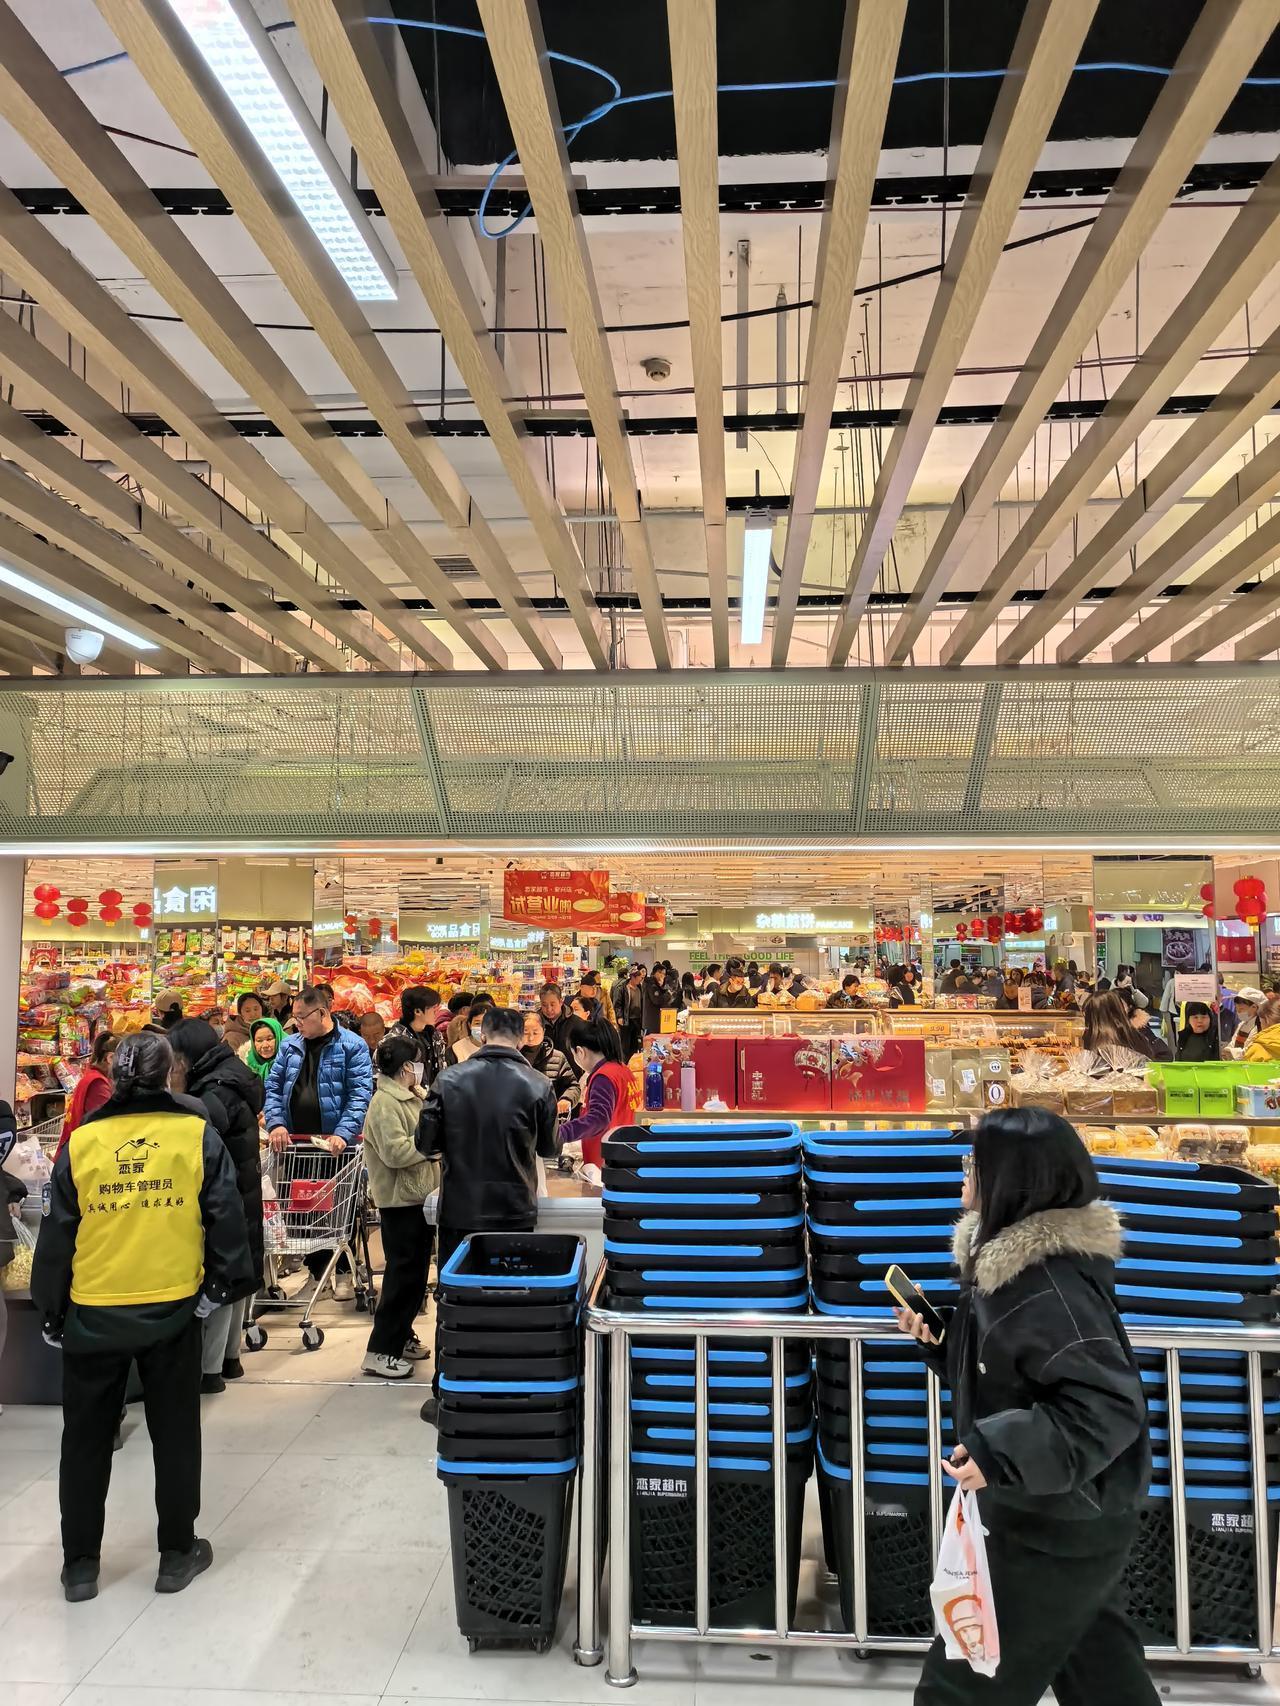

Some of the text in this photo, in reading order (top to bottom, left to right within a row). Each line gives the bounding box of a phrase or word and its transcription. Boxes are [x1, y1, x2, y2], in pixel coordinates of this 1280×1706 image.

[689, 952, 710, 960] FEEL
[743, 952, 772, 960] GOOD
[776, 952, 795, 960] LIFE
[118, 1162, 145, 1175] 恋家
[99, 1178, 173, 1195] 购物车管理员
[87, 1197, 185, 1214] 真诚用心 追求美好
[636, 1477, 687, 1492] 恋家超市
[1211, 1513, 1253, 1527] 恋家超
